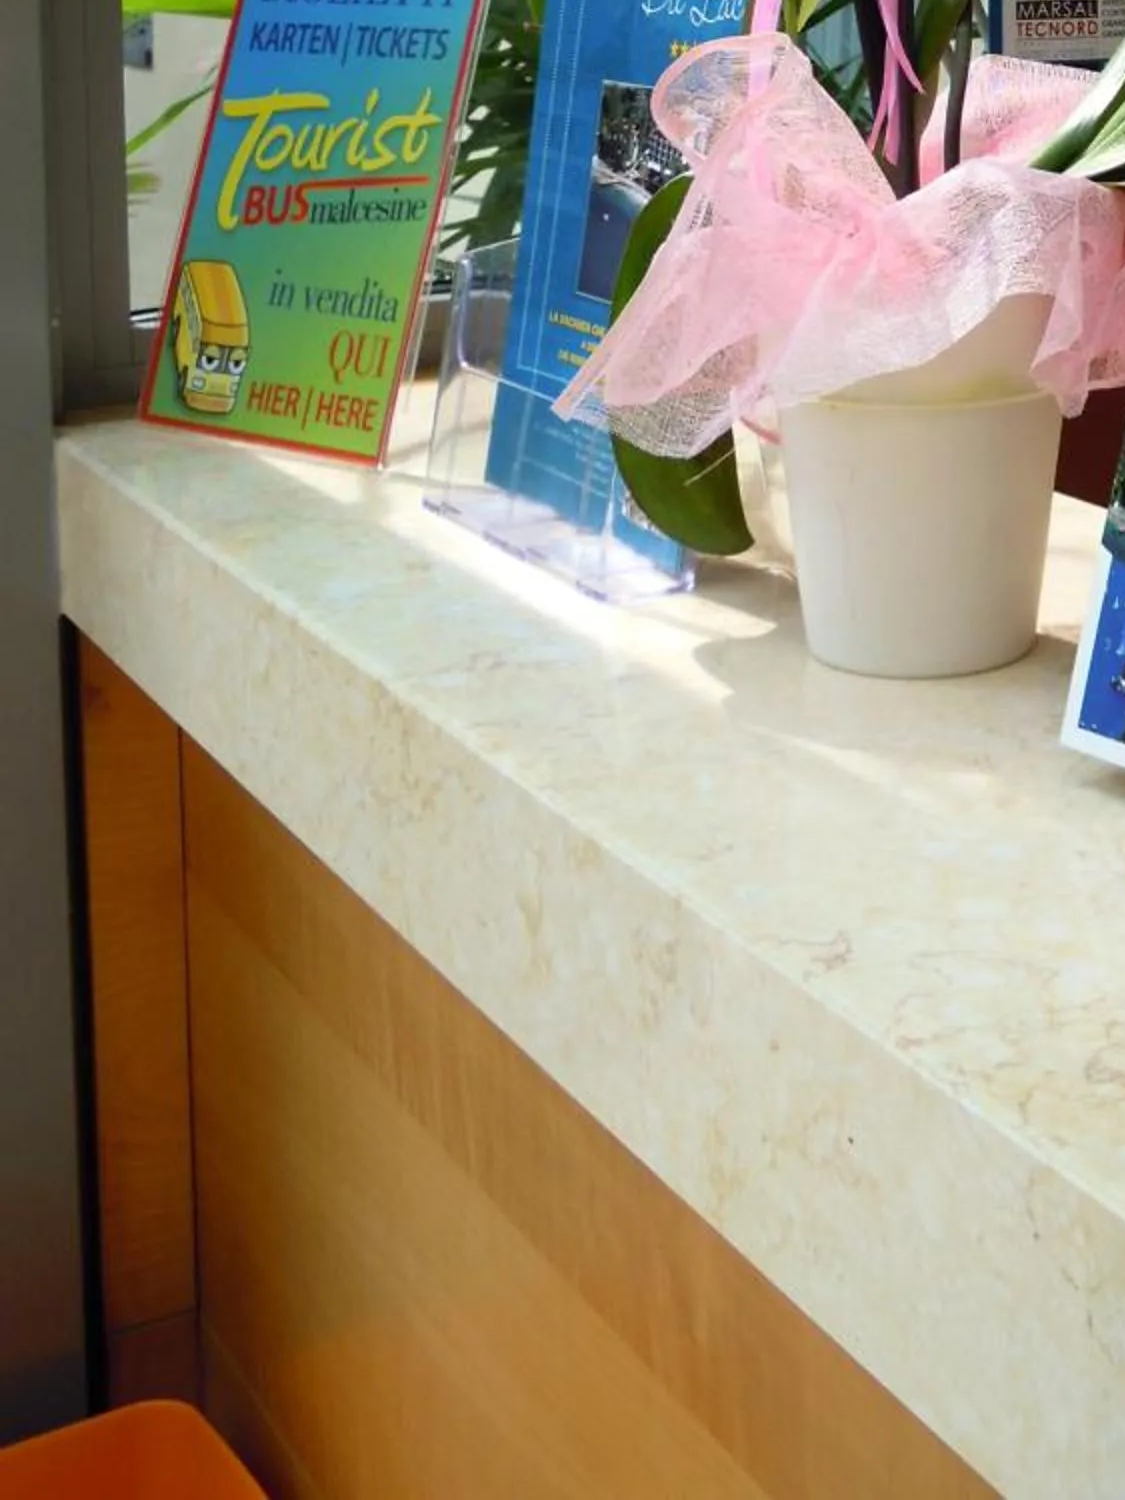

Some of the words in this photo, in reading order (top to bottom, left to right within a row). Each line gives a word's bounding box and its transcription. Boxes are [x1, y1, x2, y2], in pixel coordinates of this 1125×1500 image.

[1016, 21, 1098, 37] TECNORD
[1018, 0, 1097, 18] MARSAL
[249, 23, 341, 56] KARTEN
[356, 26, 449, 62] TICKETS
[216, 87, 443, 232] Tourist
[242, 183, 310, 227] BUS
[308, 186, 429, 225] malcesine
[268, 268, 295, 307] in
[302, 274, 399, 324] vendita
[328, 328, 393, 386] QUI
[246, 380, 301, 419] HIER
[315, 391, 380, 432] HERE
